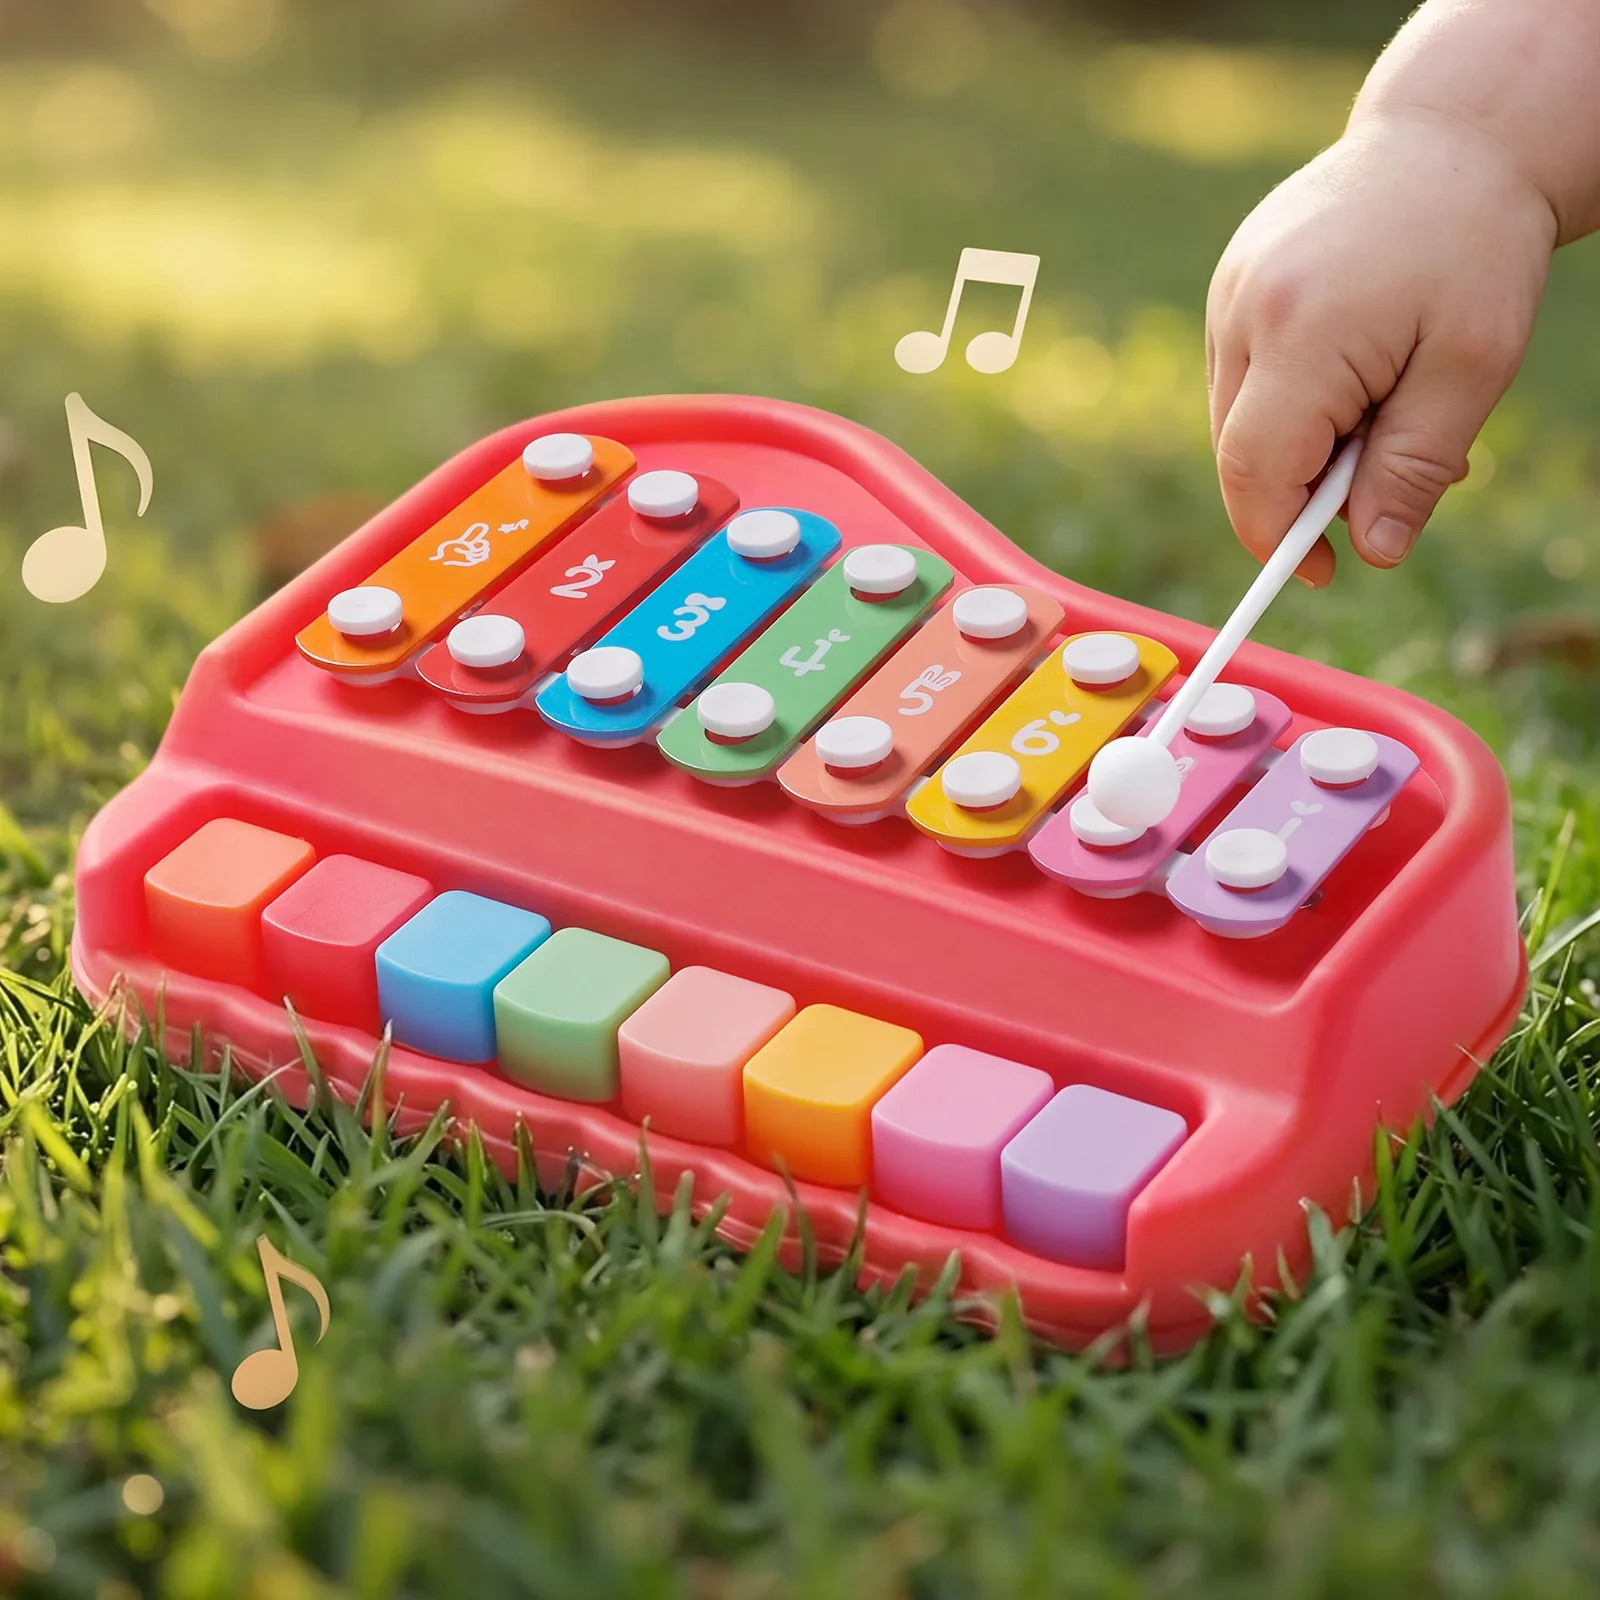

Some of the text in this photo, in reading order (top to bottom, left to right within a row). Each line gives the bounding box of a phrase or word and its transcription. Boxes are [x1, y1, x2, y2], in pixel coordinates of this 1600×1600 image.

[549, 566, 604, 599] 2
[656, 605, 711, 642] 3
[779, 639, 833, 677] 4
[897, 679, 942, 716] 5
[1011, 720, 1060, 756] 6
